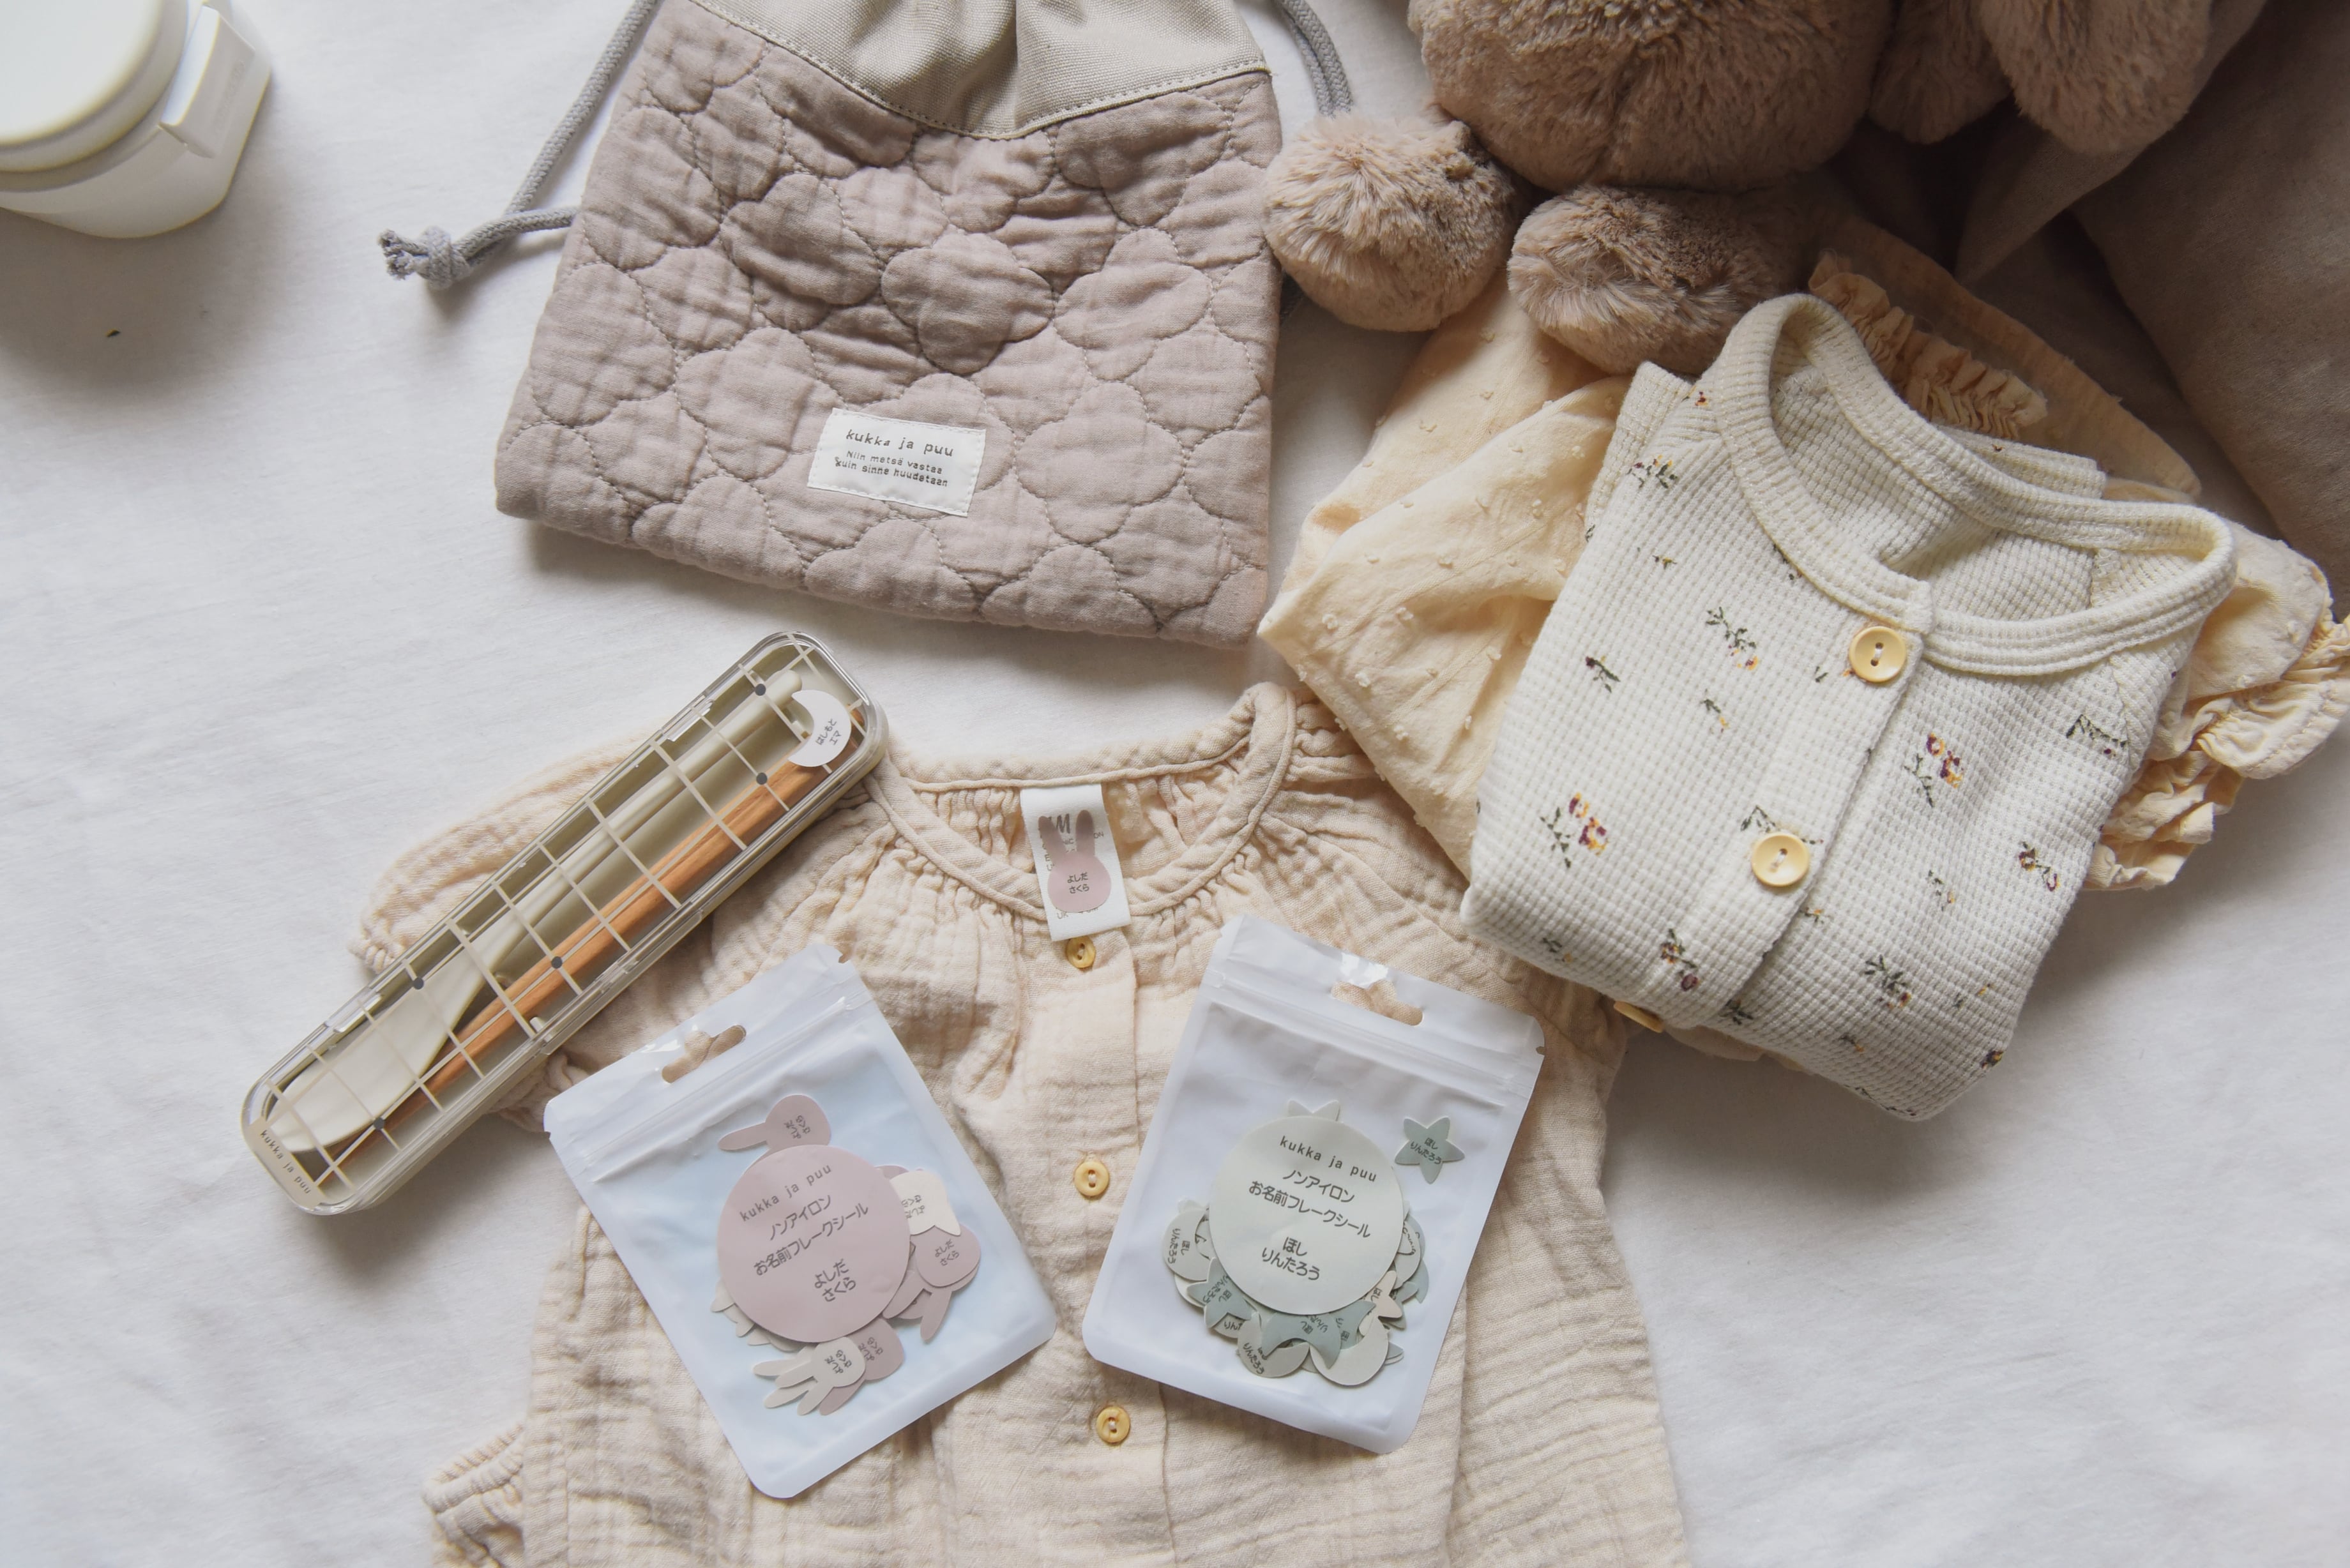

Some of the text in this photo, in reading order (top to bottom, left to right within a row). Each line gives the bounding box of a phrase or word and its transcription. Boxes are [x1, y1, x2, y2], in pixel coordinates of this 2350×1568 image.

[845, 429, 954, 457] kukka ja puu
[846, 450, 865, 460] Niin
[815, 718, 837, 746] はしもと
[1067, 871, 1089, 884] よしだ
[1069, 884, 1090, 894] さくら
[1424, 1136, 1439, 1150] ほし
[259, 1129, 311, 1193] kukka ja puu
[1279, 1135, 1377, 1184] kukka ja puu
[739, 1164, 831, 1222] kukka ja puu
[1282, 1169, 1356, 1203] ノンアイロン
[768, 1193, 832, 1242] ノンアイロン
[1248, 1179, 1372, 1239] お名前フレークシール
[752, 1201, 869, 1277] お名前フレークシール
[935, 1239, 954, 1258] よしだ
[1282, 1236, 1308, 1256] ほし
[940, 1250, 960, 1267] さくら
[1261, 1247, 1321, 1282] りんたろう
[814, 1258, 849, 1290] よしだ
[821, 1276, 857, 1303] さくら
[824, 1356, 844, 1374] よしだ
[835, 1350, 853, 1368] さくら
